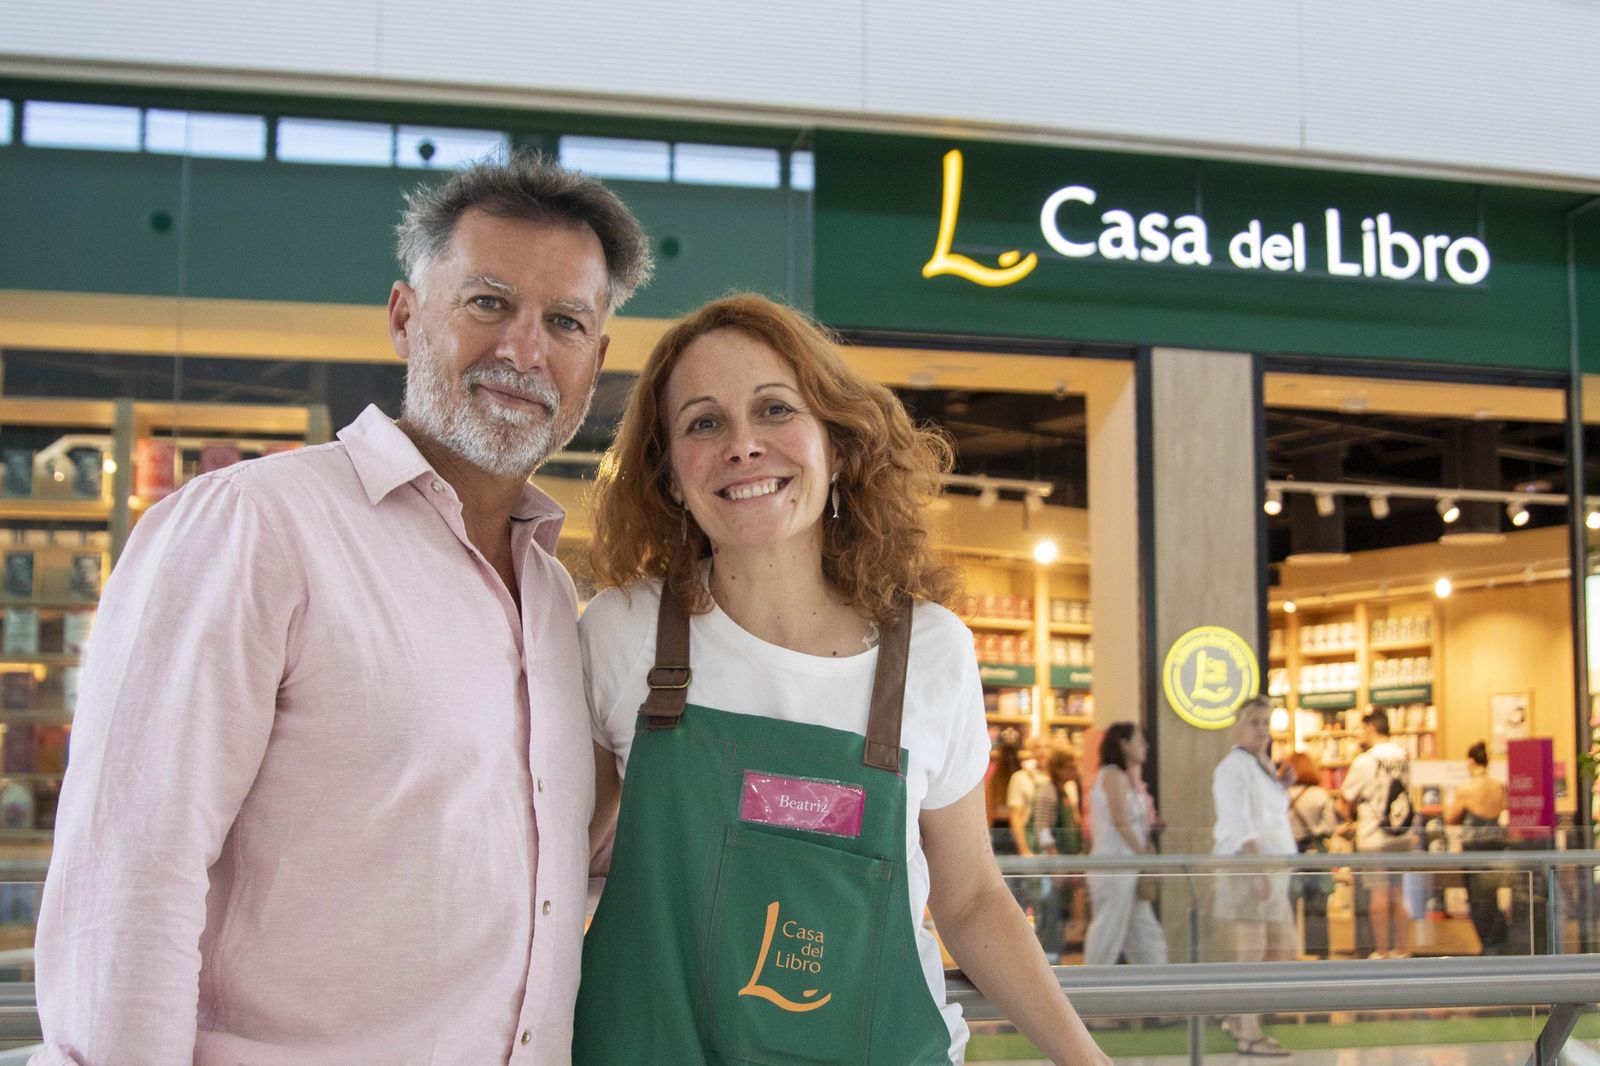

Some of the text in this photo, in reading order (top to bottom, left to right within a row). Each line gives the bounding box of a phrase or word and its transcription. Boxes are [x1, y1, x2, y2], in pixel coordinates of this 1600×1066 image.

[1040, 185, 1491, 285] Casa del Libro
[779, 794, 829, 814] Beatriz
[782, 921, 825, 944] Casa
[801, 942, 824, 958] del
[775, 951, 822, 973] Libro
